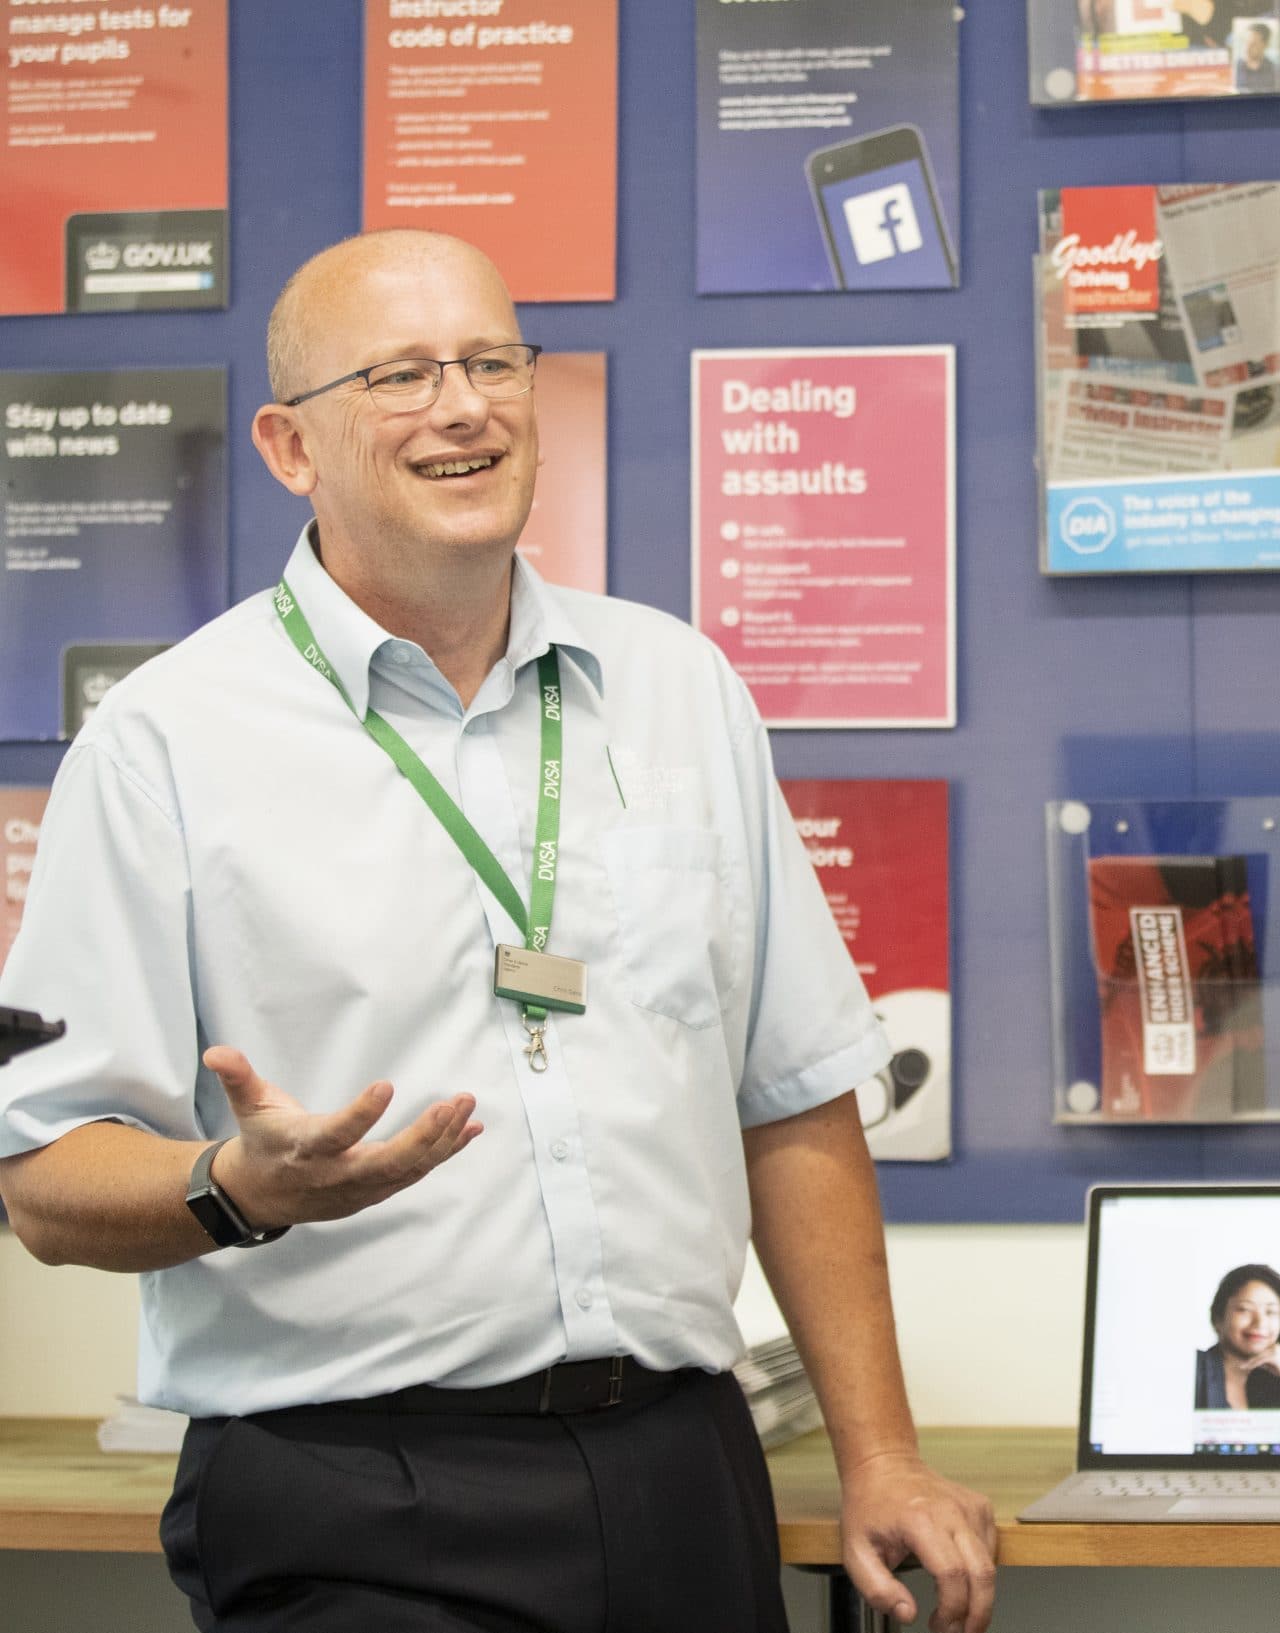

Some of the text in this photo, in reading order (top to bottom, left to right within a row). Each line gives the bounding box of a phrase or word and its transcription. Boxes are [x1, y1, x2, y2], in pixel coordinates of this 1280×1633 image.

[9, 5, 192, 36] manage tests for
[389, 20, 573, 49] code of practice
[8, 36, 130, 67] your pupils
[123, 241, 213, 267] GOV.UK
[722, 380, 856, 417] Dealing
[6, 401, 171, 432] Stay up to date
[6, 434, 119, 457] with news
[722, 421, 799, 454] with
[722, 463, 867, 496] assaults
[1069, 515, 1107, 537] DIA
[304, 643, 332, 680] DVSA
[544, 685, 560, 721] DVSA
[544, 759, 560, 799] DVSA
[538, 841, 556, 881] DVSA
[1139, 914, 1168, 1022] ENHANCED
